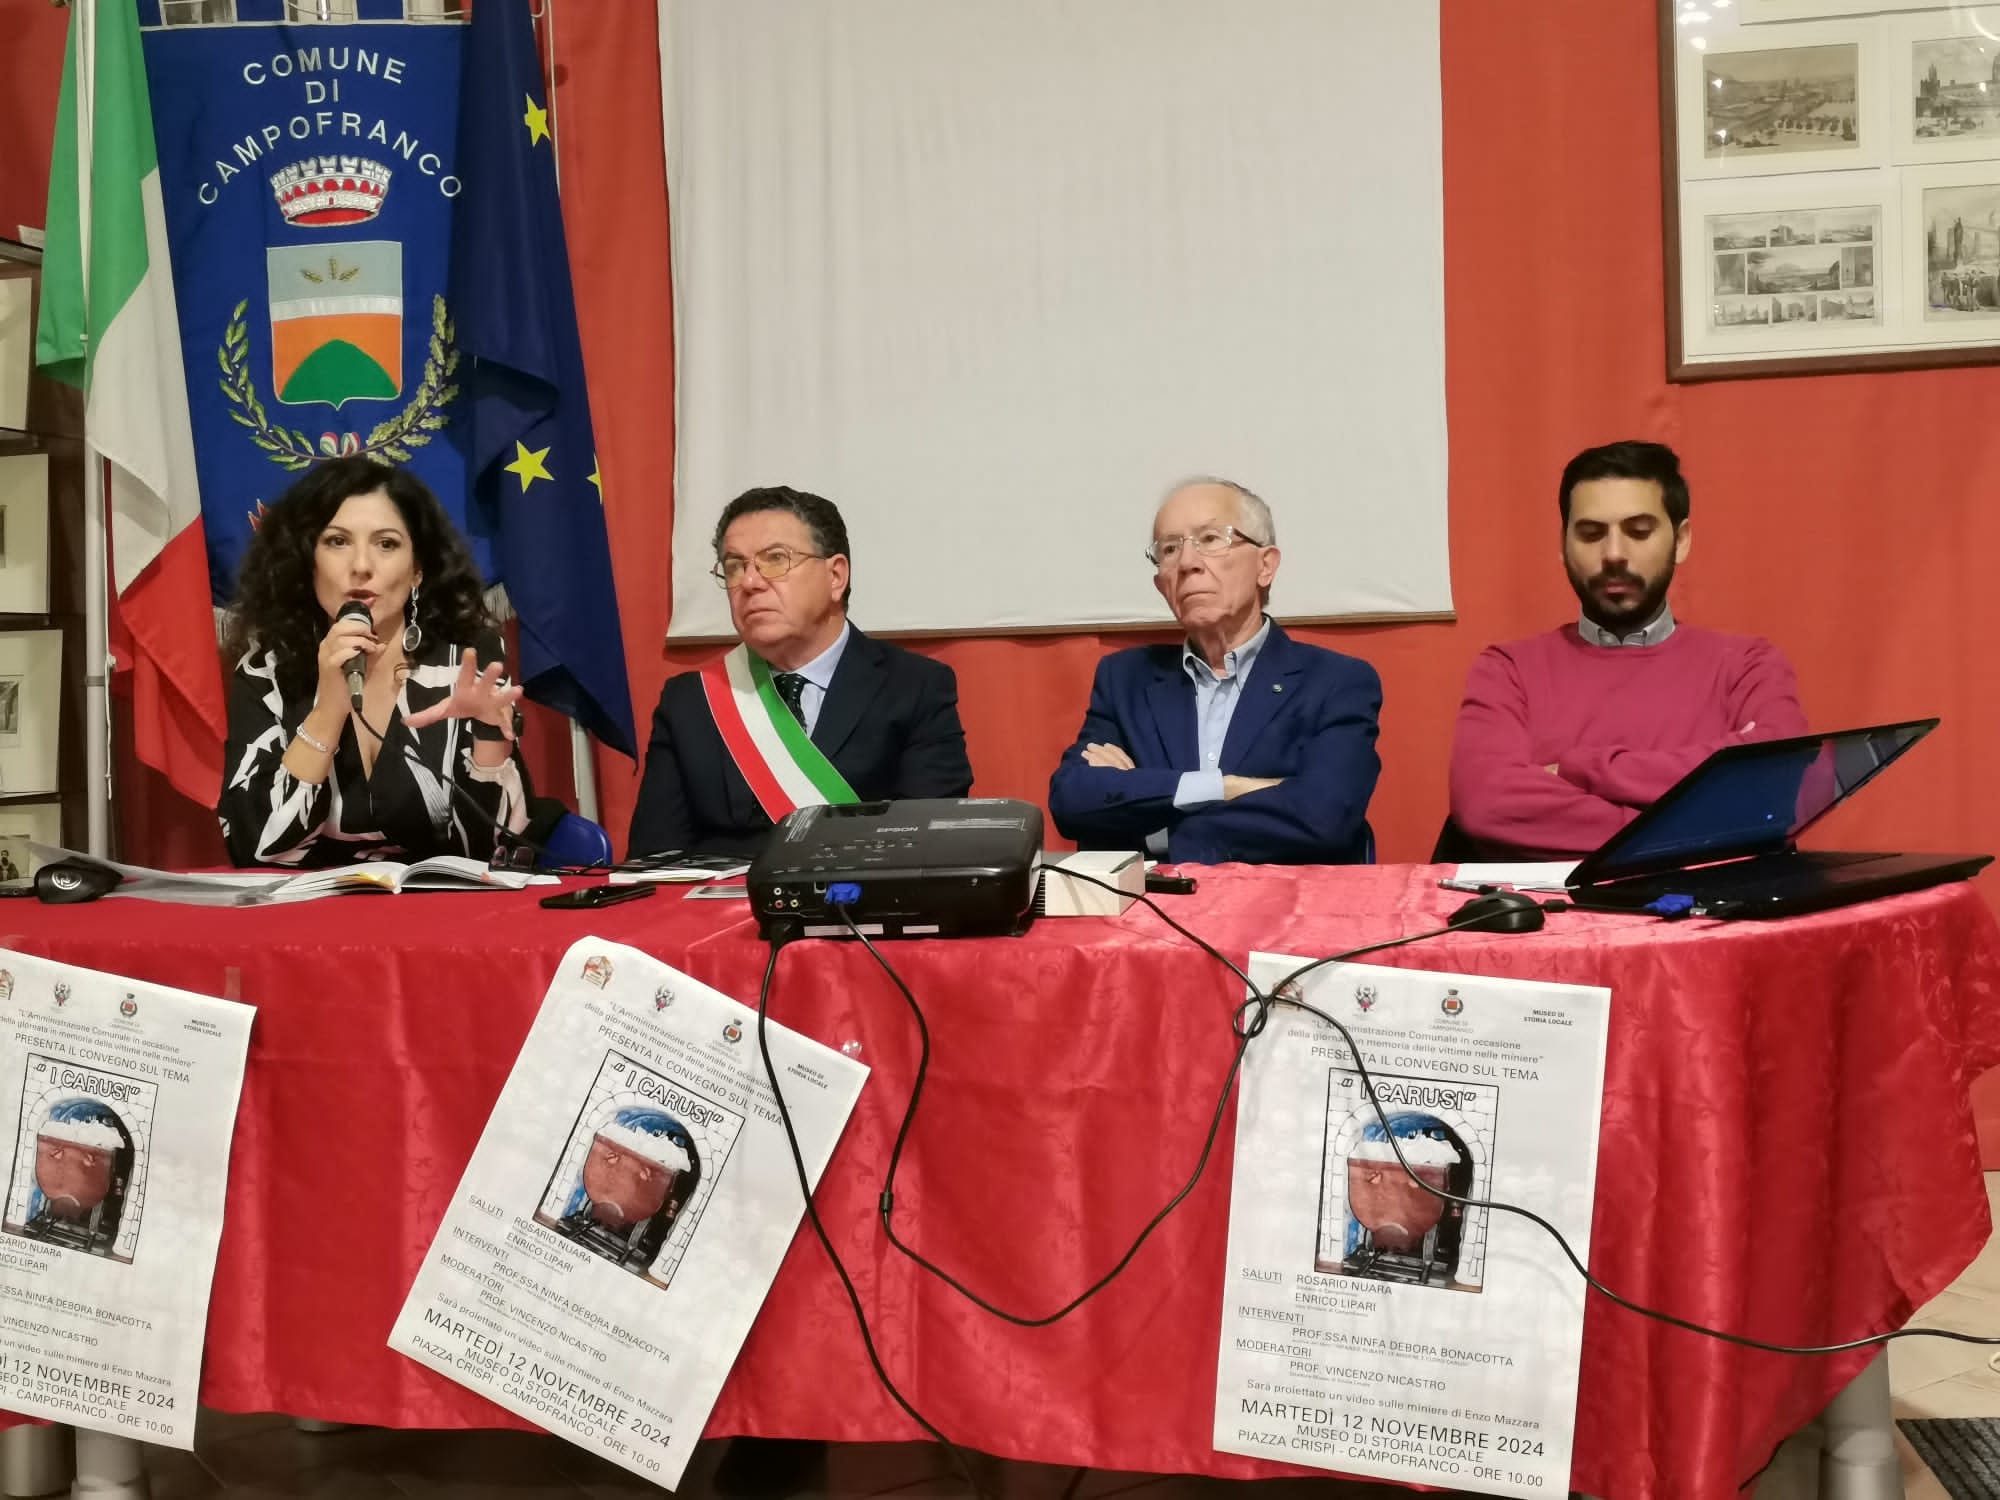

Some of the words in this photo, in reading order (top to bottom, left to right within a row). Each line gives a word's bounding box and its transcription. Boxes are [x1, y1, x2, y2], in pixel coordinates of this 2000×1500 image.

[243, 47, 406, 85] COMUNE
[305, 78, 339, 104] DI
[199, 111, 462, 205] CAMPOFRANCO
[1313, 1030, 1352, 1045] giorna
[14, 1032, 66, 1053] PRESENTA
[68, 1045, 77, 1055] IL
[79, 1047, 137, 1070] CONVEGNO
[139, 1062, 159, 1075] SUL
[162, 1068, 190, 1083] TEMA
[1311, 1046, 1376, 1063] PRESETA
[1380, 1054, 1391, 1065] IL
[1394, 1055, 1469, 1074] CONVEGNO
[1472, 1064, 1499, 1077] SUL
[1502, 1067, 1539, 1081] TEMA
[598, 1025, 653, 1059] PRESENTA
[655, 1054, 665, 1065] IL
[665, 1059, 726, 1097] CONVEGNO
[728, 1092, 751, 1109] SUL
[752, 1104, 783, 1126] TEMA
[736, 1069, 776, 1094] occasion
[468, 1194, 503, 1217] SALUTI
[29, 1243, 62, 1258] NUARA
[453, 1226, 509, 1260] INTERVENTI
[506, 1232, 543, 1256] ENRICO
[543, 1251, 573, 1273] LIPARI
[513, 1216, 557, 1244] ROSARIO
[557, 1240, 592, 1263] NUARA
[19, 1257, 48, 1272] LIPARI
[440, 1253, 504, 1292] MODERATORI
[1241, 1267, 1282, 1282] SALUTI
[1296, 1273, 1348, 1290] ROSARIO
[1351, 1280, 1392, 1295] NUARA
[1238, 1305, 1304, 1324] INTERVENTI
[1295, 1292, 1337, 1307] ENRICO
[1340, 1298, 1376, 1312] LIPARI
[2, 1316, 49, 1334] VINCENZO
[51, 1328, 98, 1346] NICASTRO
[509, 1305, 557, 1336] VINCENZO
[558, 1331, 607, 1362] NICASTRO
[1235, 1338, 1311, 1358] MODERATORI
[1351, 1335, 1386, 1349] NINFA
[1389, 1340, 1437, 1356] DEBORA
[1440, 1347, 1513, 1366] BONACOTTA
[13, 1358, 31, 1375] 12
[36, 1365, 131, 1398] NOVEMBRE
[137, 1389, 175, 1410] 2024
[22, 1376, 33, 1388] DI
[36, 1380, 78, 1399] STORIA
[82, 1391, 126, 1410] LOCALE
[423, 1305, 504, 1358] MARTEDÌ
[506, 1351, 526, 1370] 12
[529, 1364, 628, 1424] NOVEMBRE
[630, 1418, 672, 1448] 2024
[464, 1348, 509, 1377] MUSEO
[511, 1372, 524, 1385] DI
[525, 1380, 570, 1409] STORIA
[571, 1404, 618, 1434] LOCALE
[1325, 1365, 1384, 1383] VINCENZO
[1386, 1374, 1446, 1391] NICASTRO
[16, 1389, 106, 1418] CAMPOFRANCO
[117, 1412, 140, 1427] ORE
[145, 1419, 173, 1435] 10.00
[411, 1335, 454, 1363] PIAZZA
[455, 1358, 493, 1384] CRISPI
[501, 1382, 594, 1436] CAMPOFRANCO
[602, 1435, 628, 1455] ORE
[630, 1450, 660, 1472] 10.00
[1241, 1395, 1333, 1426] MARTEDÌ
[1342, 1412, 1363, 1430] 12
[1371, 1417, 1489, 1449] NOVEMBRE
[1496, 1435, 1545, 1457] 2024
[1296, 1424, 1349, 1442] MUSEO
[1353, 1432, 1367, 1445] DI
[1371, 1435, 1424, 1454] STORIA
[1428, 1444, 1484, 1463] LOCALE
[1238, 1429, 1287, 1447] PIAZZA
[1291, 1437, 1335, 1455] CRISPI
[1347, 1446, 1460, 1474] CAMPOFRANCO
[1473, 1465, 1502, 1481] ORE
[1508, 1470, 1543, 1487] 10.00
